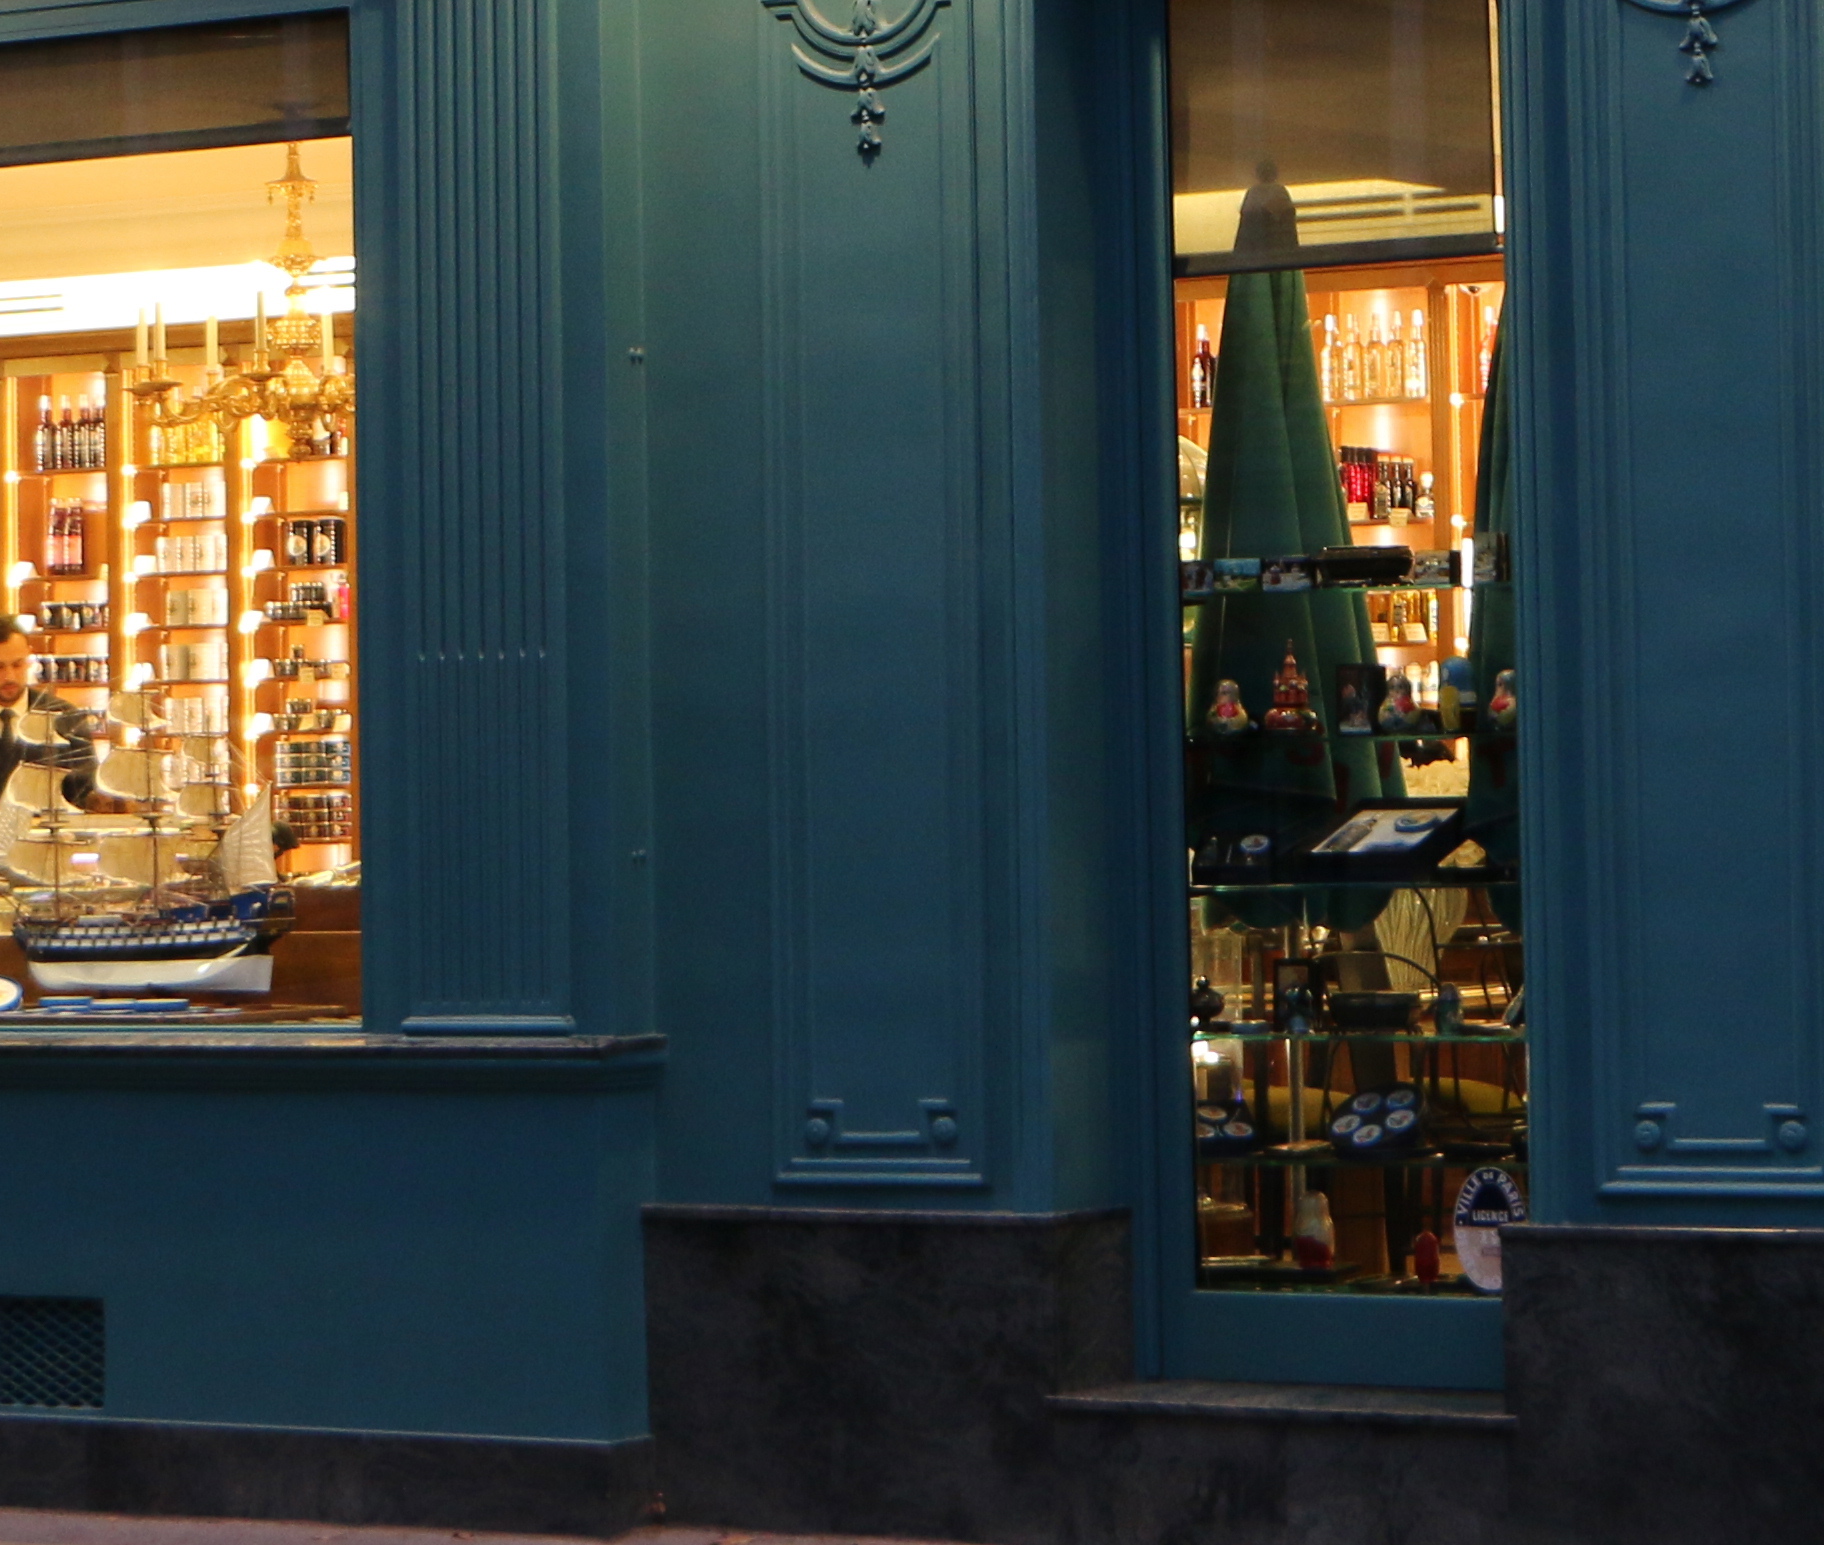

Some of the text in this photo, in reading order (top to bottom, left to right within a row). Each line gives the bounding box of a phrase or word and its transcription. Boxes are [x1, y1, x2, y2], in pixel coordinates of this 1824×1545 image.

[1456, 1176, 1482, 1215] VILLE
[1497, 1173, 1525, 1217] PARIS
[1472, 1209, 1509, 1222] LICENCE
